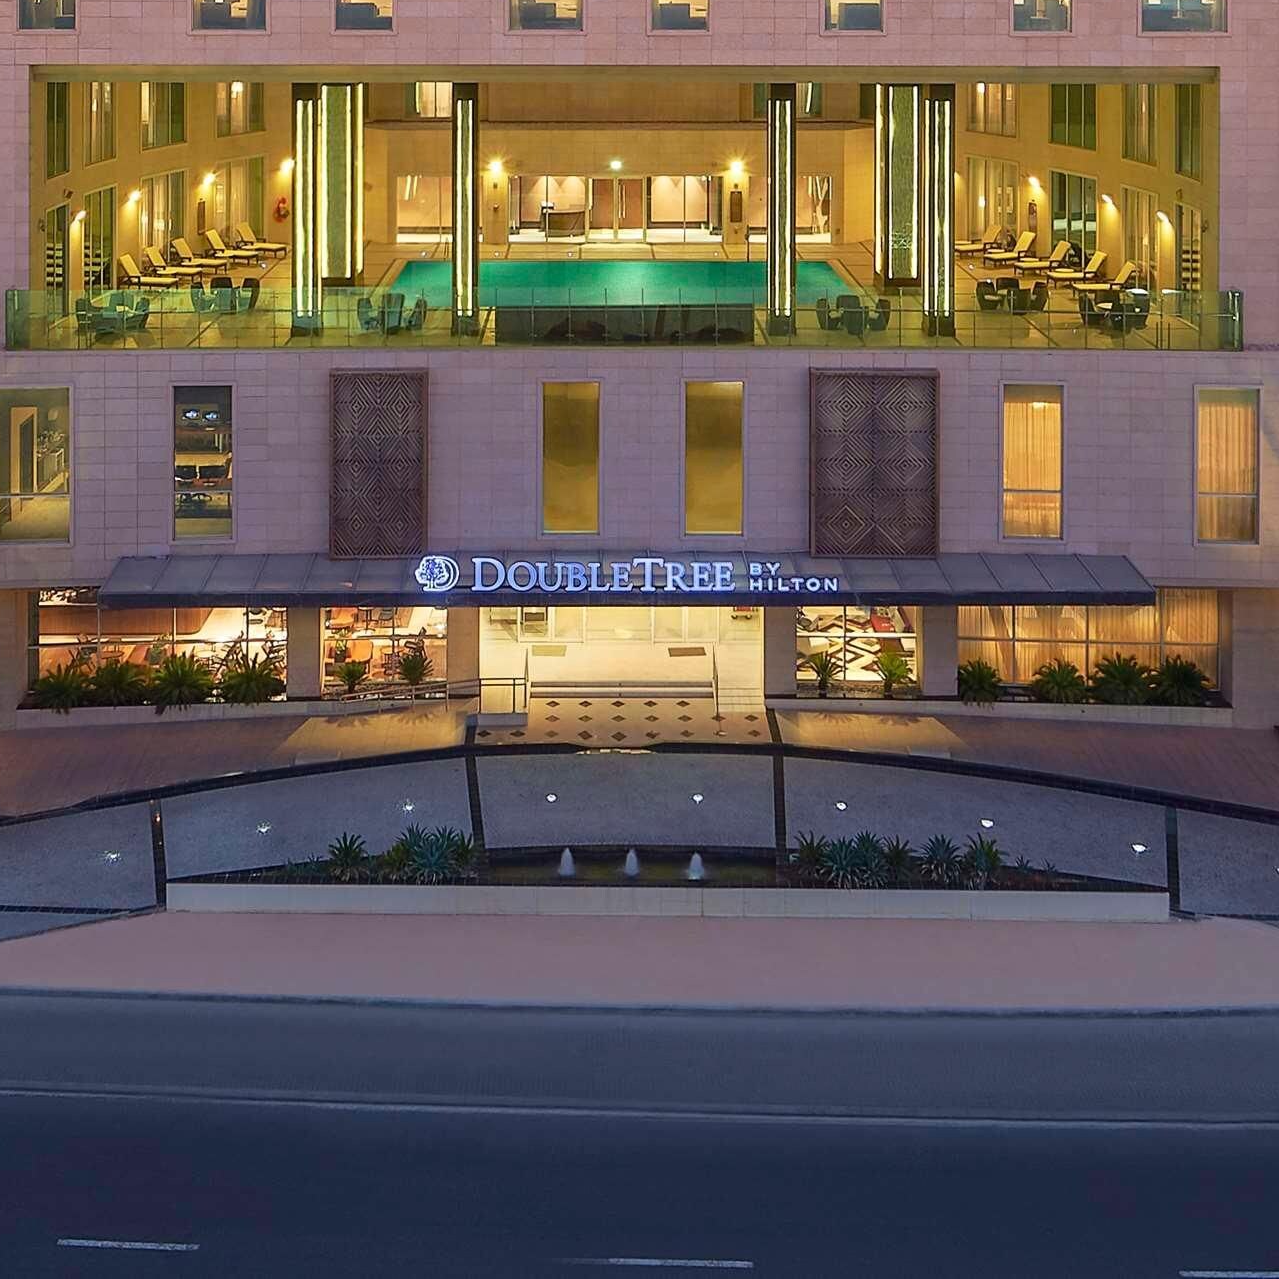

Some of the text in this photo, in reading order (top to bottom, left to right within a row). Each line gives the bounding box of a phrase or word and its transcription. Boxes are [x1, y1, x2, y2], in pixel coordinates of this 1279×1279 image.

[471, 556, 736, 593] DOUBLETREE
[749, 562, 780, 576] BY
[749, 578, 839, 592] HILTON
